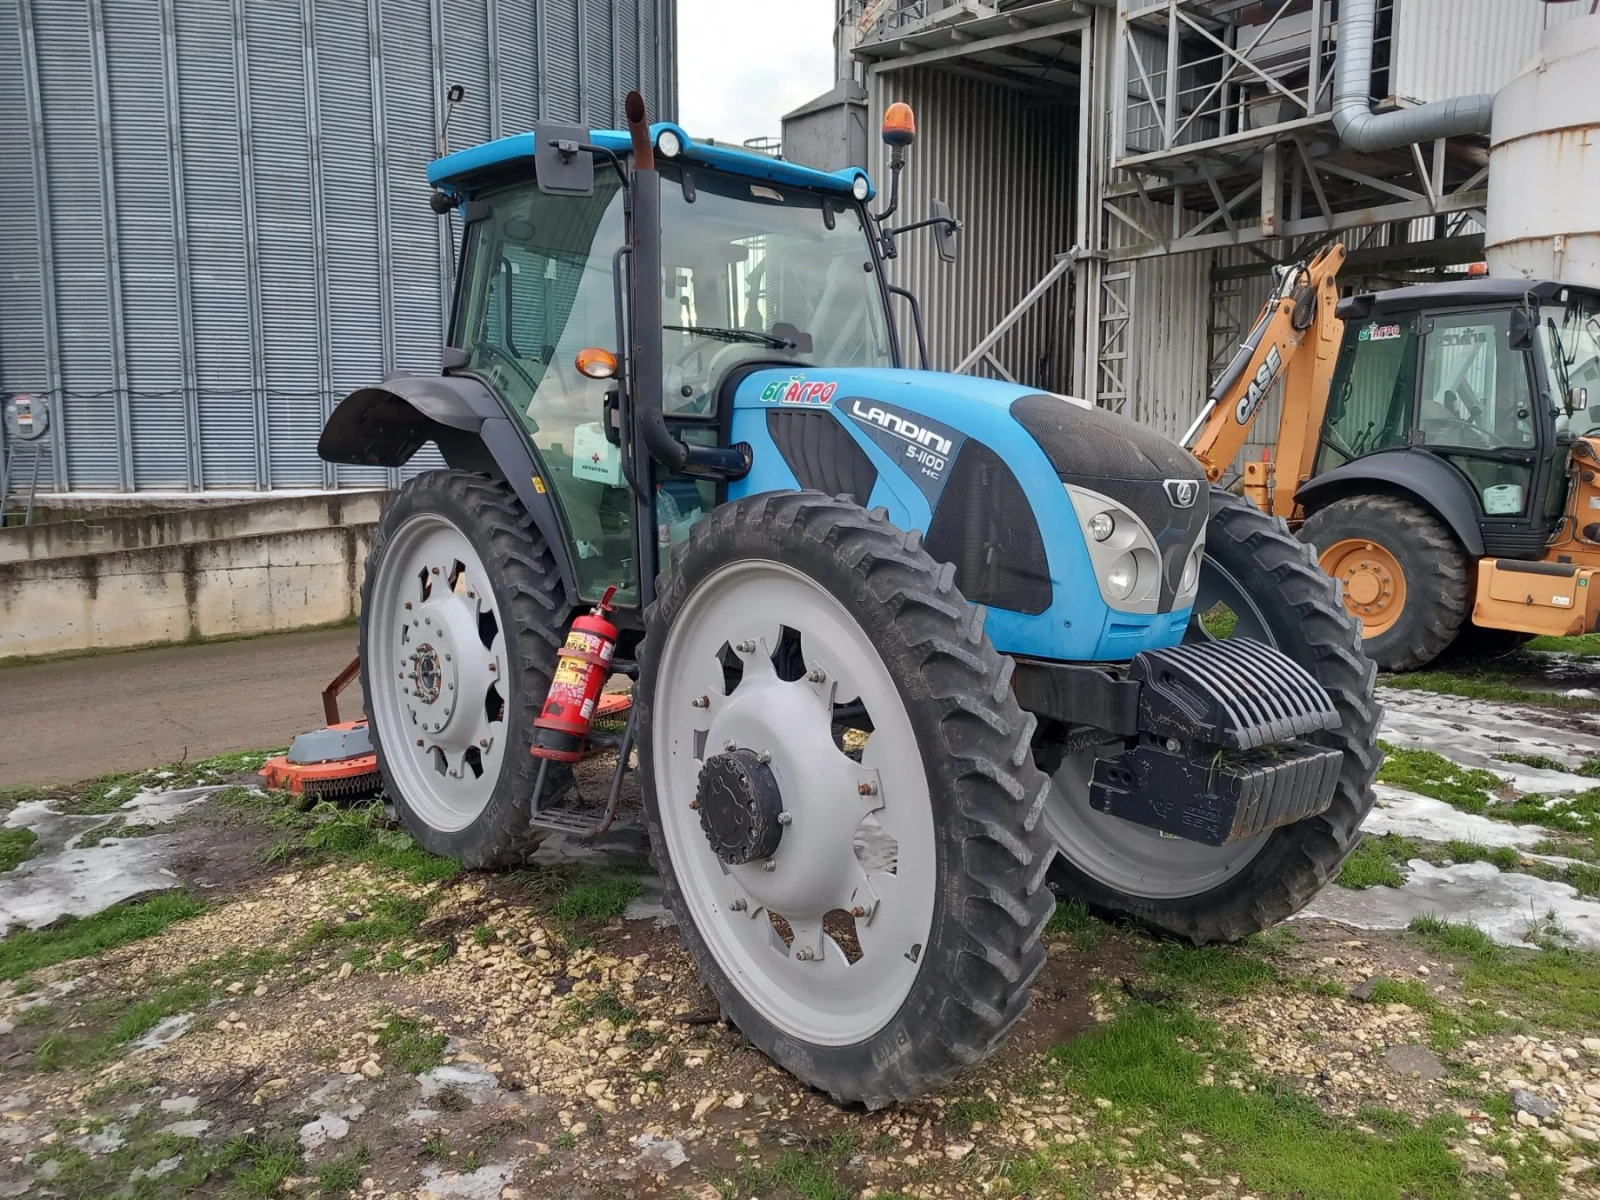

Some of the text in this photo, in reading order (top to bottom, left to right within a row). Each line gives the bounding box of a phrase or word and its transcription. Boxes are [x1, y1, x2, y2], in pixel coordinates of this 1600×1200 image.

[1359, 324, 1401, 341] БГАГРО
[760, 380, 838, 404] БГАГРО
[1235, 342, 1282, 425] CASE
[852, 400, 953, 455] LANDINI
[905, 445, 945, 472] 5-110D
[921, 468, 940, 480] HC
[661, 575, 687, 620] BKT
